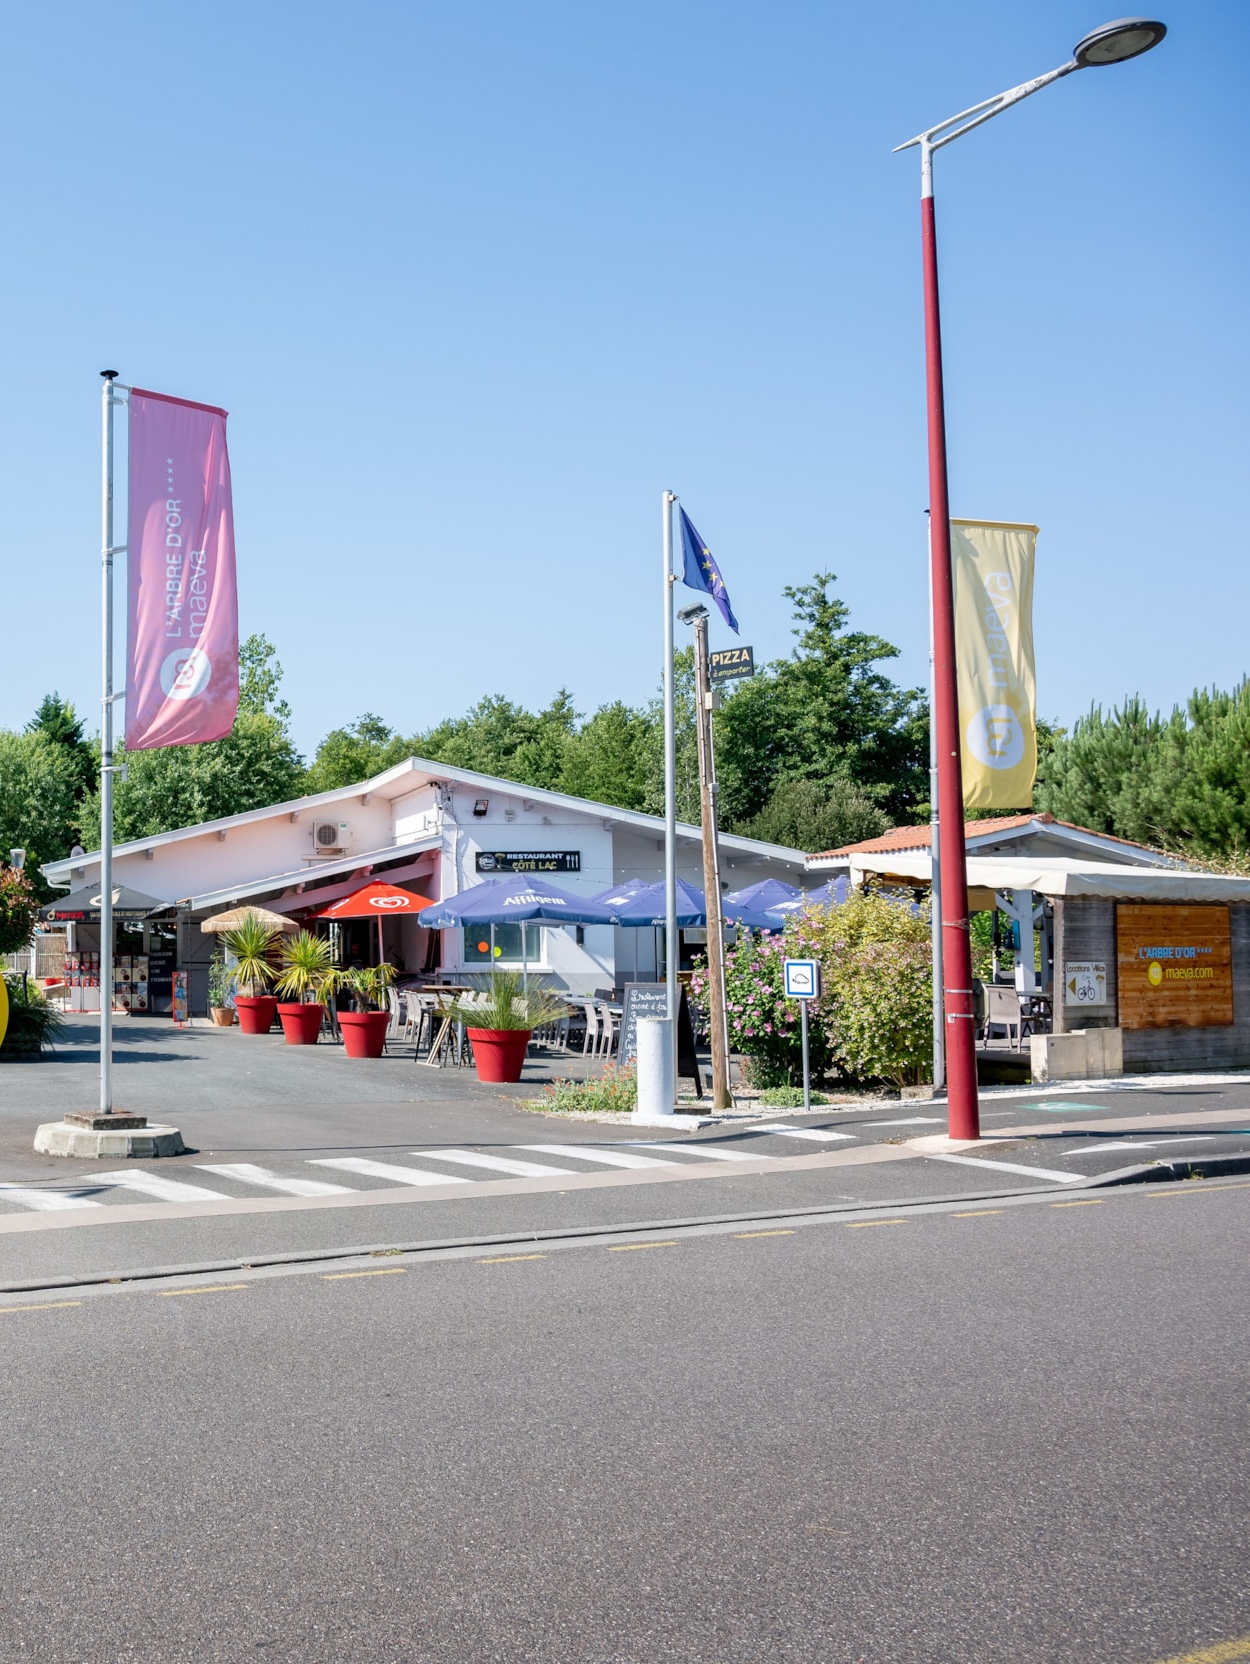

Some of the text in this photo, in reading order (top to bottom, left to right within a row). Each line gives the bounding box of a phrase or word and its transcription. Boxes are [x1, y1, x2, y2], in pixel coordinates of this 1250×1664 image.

[165, 499, 182, 638] L'ARBRE D'OR
[189, 549, 207, 639] maeva
[984, 571, 1013, 688] maeva
[712, 648, 750, 667] PIZZA
[506, 852, 564, 860] RESTAURANT
[512, 859, 558, 870] CÔTÉ LAC
[502, 893, 567, 906] Affligem
[1139, 946, 1197, 959] L'ARBRE D'OR
[1165, 967, 1214, 979] maeva.com
